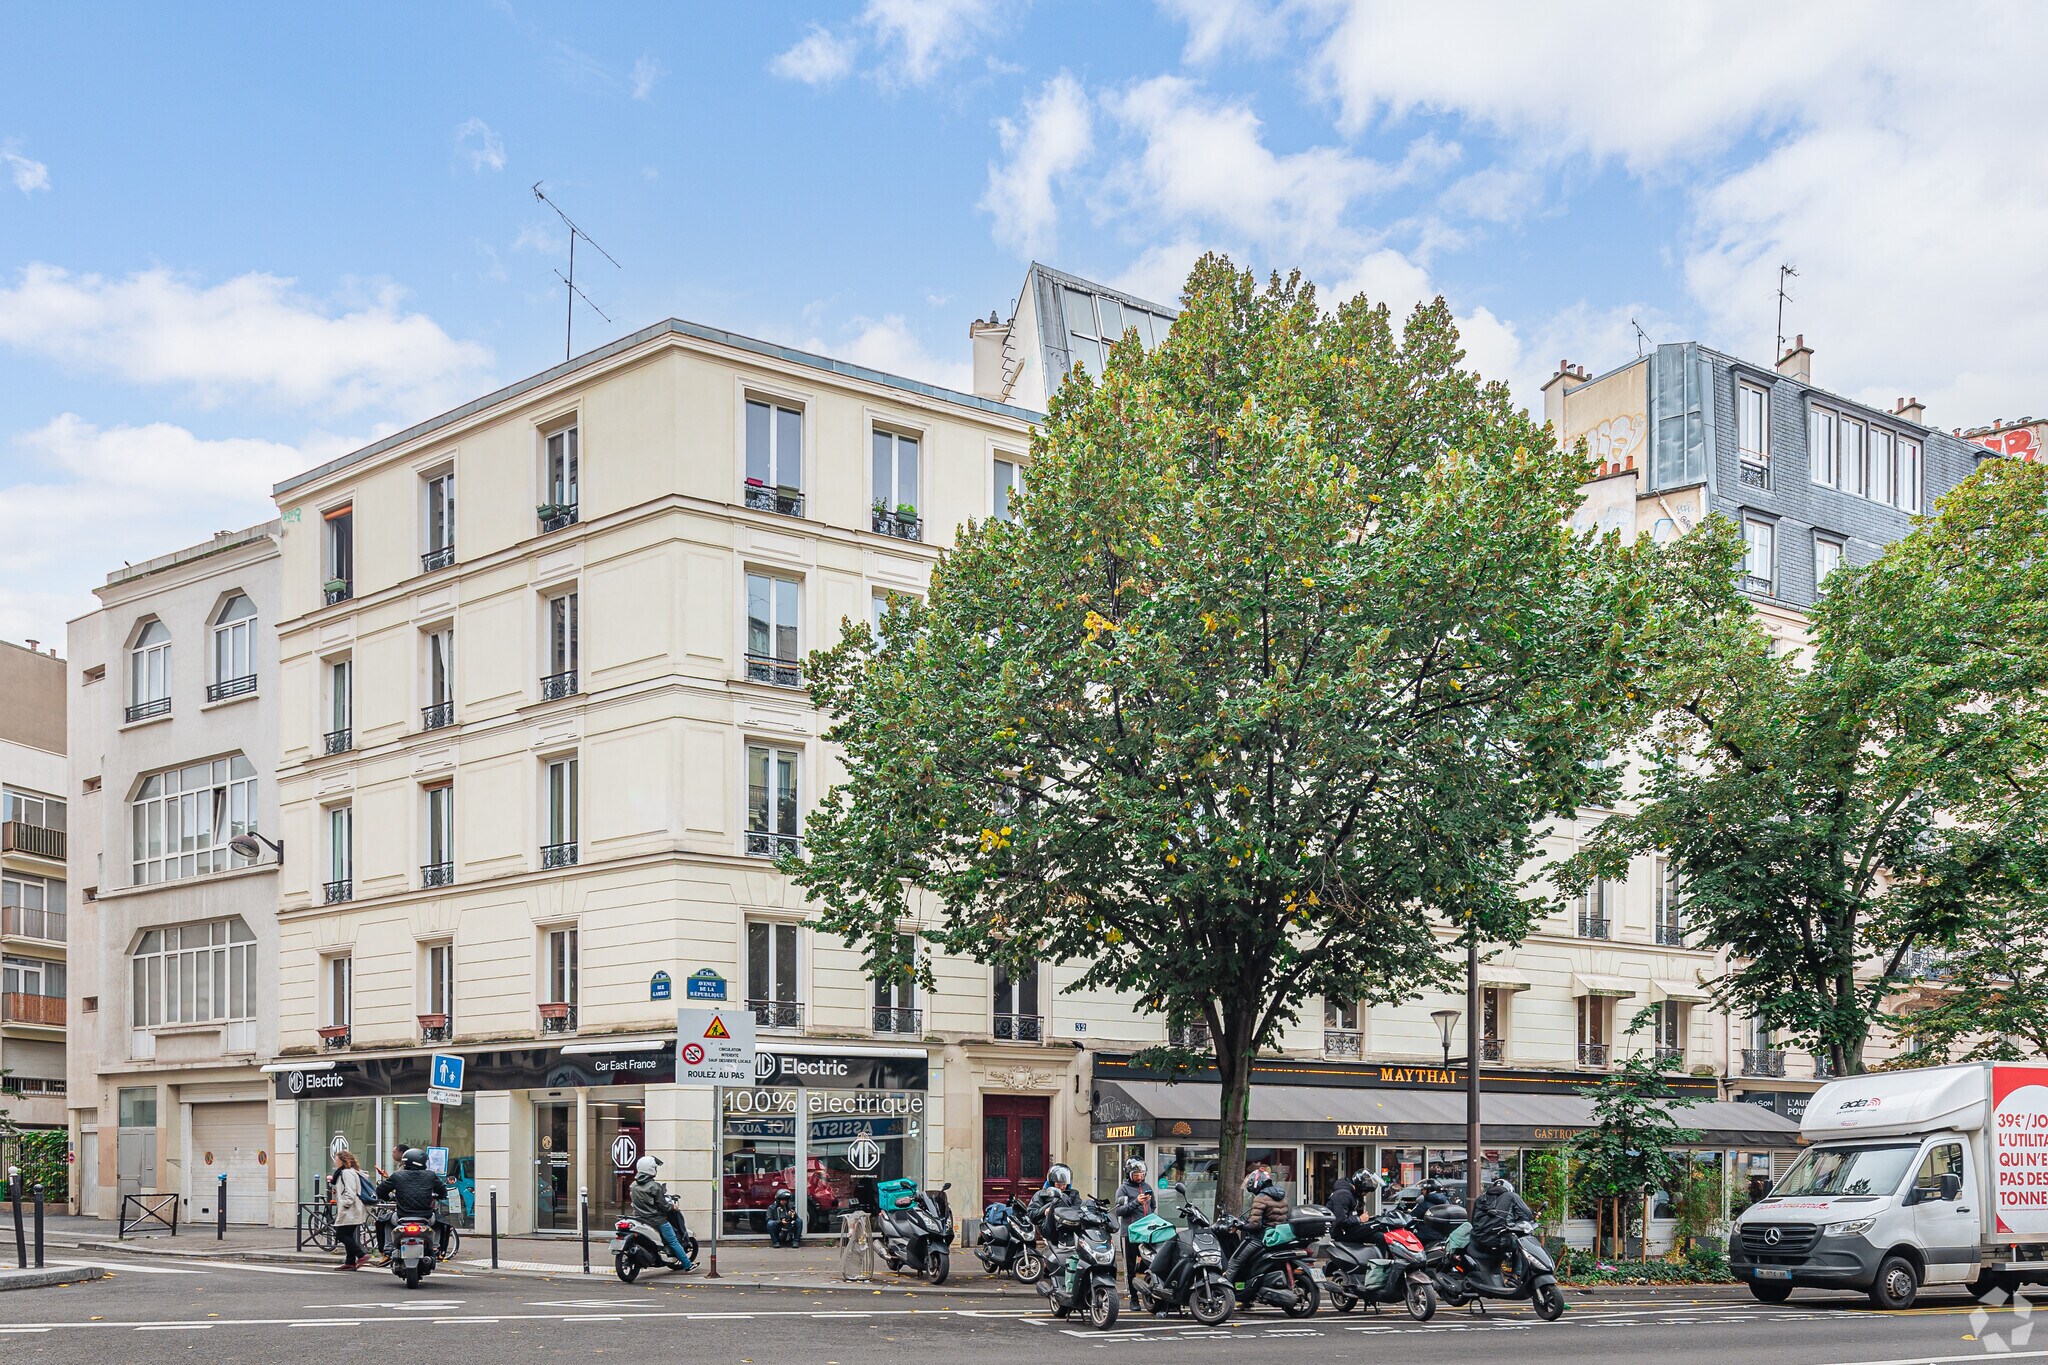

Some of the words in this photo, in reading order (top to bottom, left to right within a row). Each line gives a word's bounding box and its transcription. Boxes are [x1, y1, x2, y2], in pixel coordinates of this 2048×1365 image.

[1075, 1023, 1086, 1031] 32
[595, 1061, 609, 1071] Car
[610, 1061, 628, 1070] East
[629, 1059, 656, 1069] France
[781, 1058, 848, 1075] Electric
[687, 1070, 716, 1078] ROULEZ
[1380, 1068, 1457, 1084] MAYTHAI
[290, 1072, 302, 1091] MG
[306, 1073, 343, 1088] Electric
[725, 1091, 797, 1113] 100%
[809, 1091, 923, 1118] électrique
[1840, 1099, 1868, 1109] ada
[1106, 1125, 1136, 1138] MAYTHAI
[1337, 1125, 1388, 1136] MAYTHAI
[613, 1137, 634, 1165] MG
[850, 1141, 877, 1168] MG
[1999, 1152, 2024, 1167] QUI
[2000, 1172, 2025, 1186] PAS
[2027, 1172, 2048, 1186] DES
[2000, 1191, 2048, 1205] TONNE
